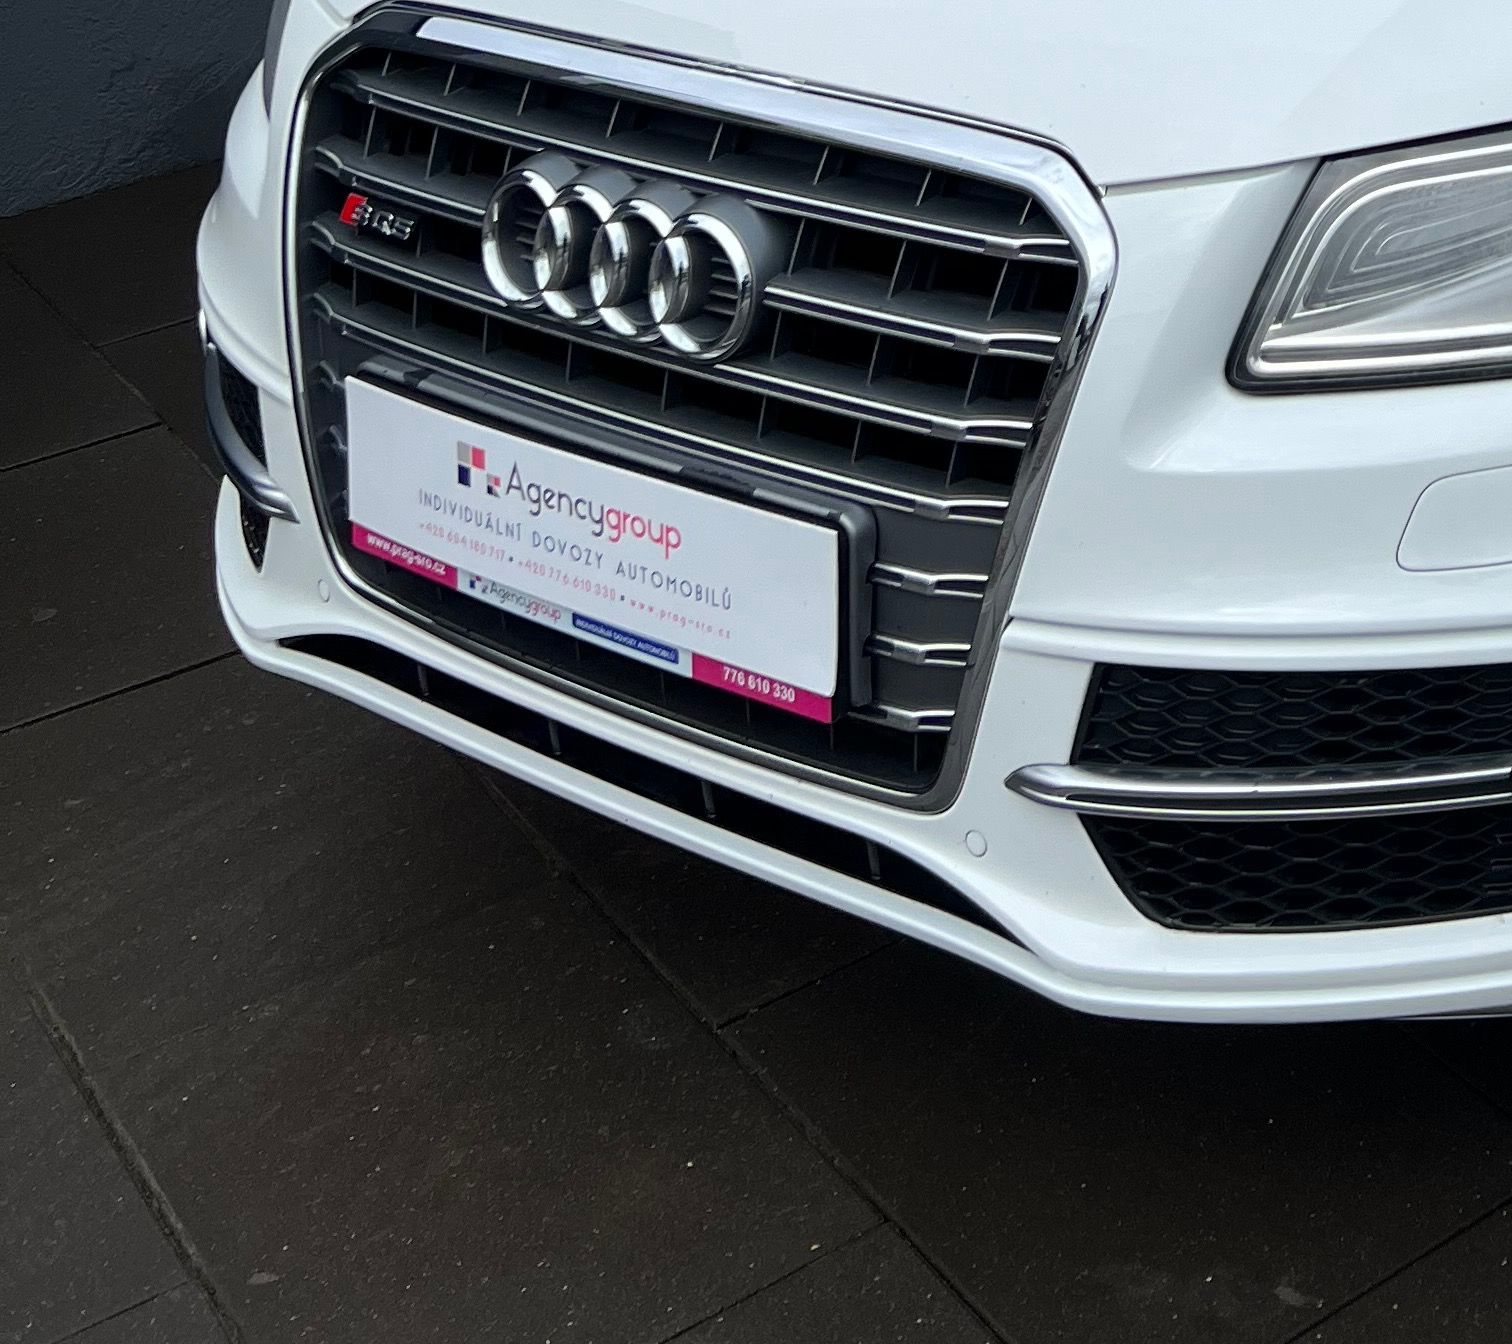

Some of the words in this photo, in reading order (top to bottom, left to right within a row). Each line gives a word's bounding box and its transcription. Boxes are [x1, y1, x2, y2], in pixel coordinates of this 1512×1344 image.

[418, 487, 522, 542] INDIVIDUÁLNÍ
[532, 530, 604, 569] DOVOZY
[505, 460, 682, 560] Agencygroup
[723, 665, 745, 687] 776
[748, 674, 770, 695] 610
[772, 682, 796, 703] 330
